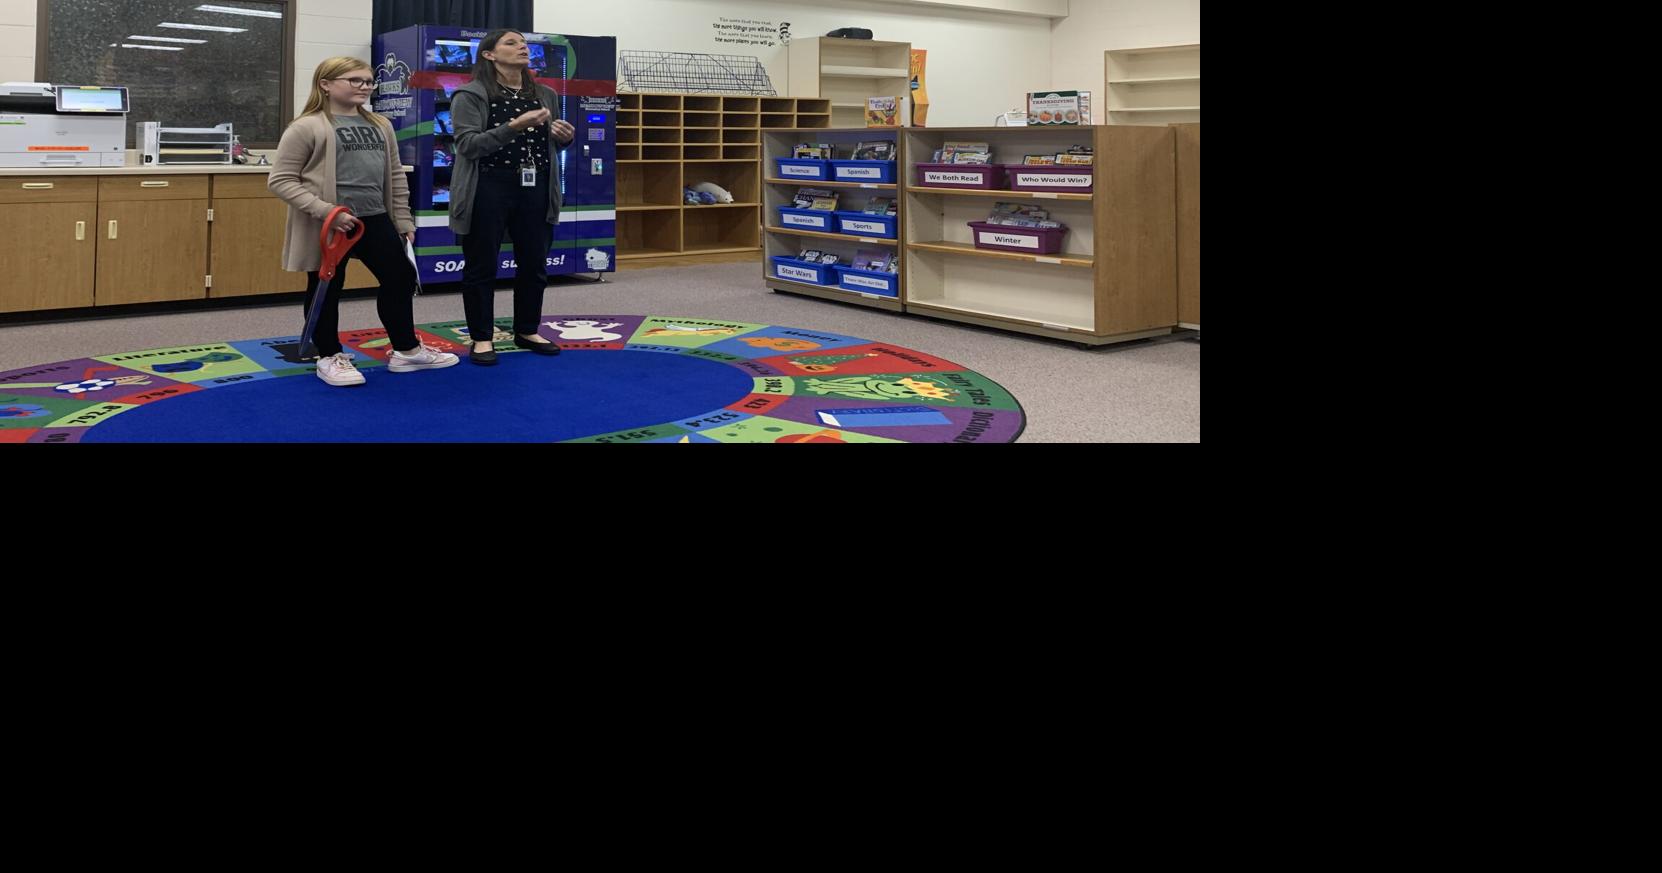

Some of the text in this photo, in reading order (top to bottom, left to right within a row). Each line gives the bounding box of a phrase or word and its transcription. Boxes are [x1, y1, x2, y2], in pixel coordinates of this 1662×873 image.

[336, 126, 384, 144] GIRL
[342, 143, 384, 152] WONDERFU
[650, 319, 748, 328] Mythology
[780, 330, 843, 342] Money
[113, 345, 228, 361] Literature
[871, 348, 937, 368] Holidays
[212, 375, 254, 384] 800
[764, 378, 783, 393] 398.2
[136, 388, 179, 400] 796
[942, 374, 992, 406] Fairy Tales
[67, 405, 122, 424] 792.8
[685, 412, 740, 428] 523.4
